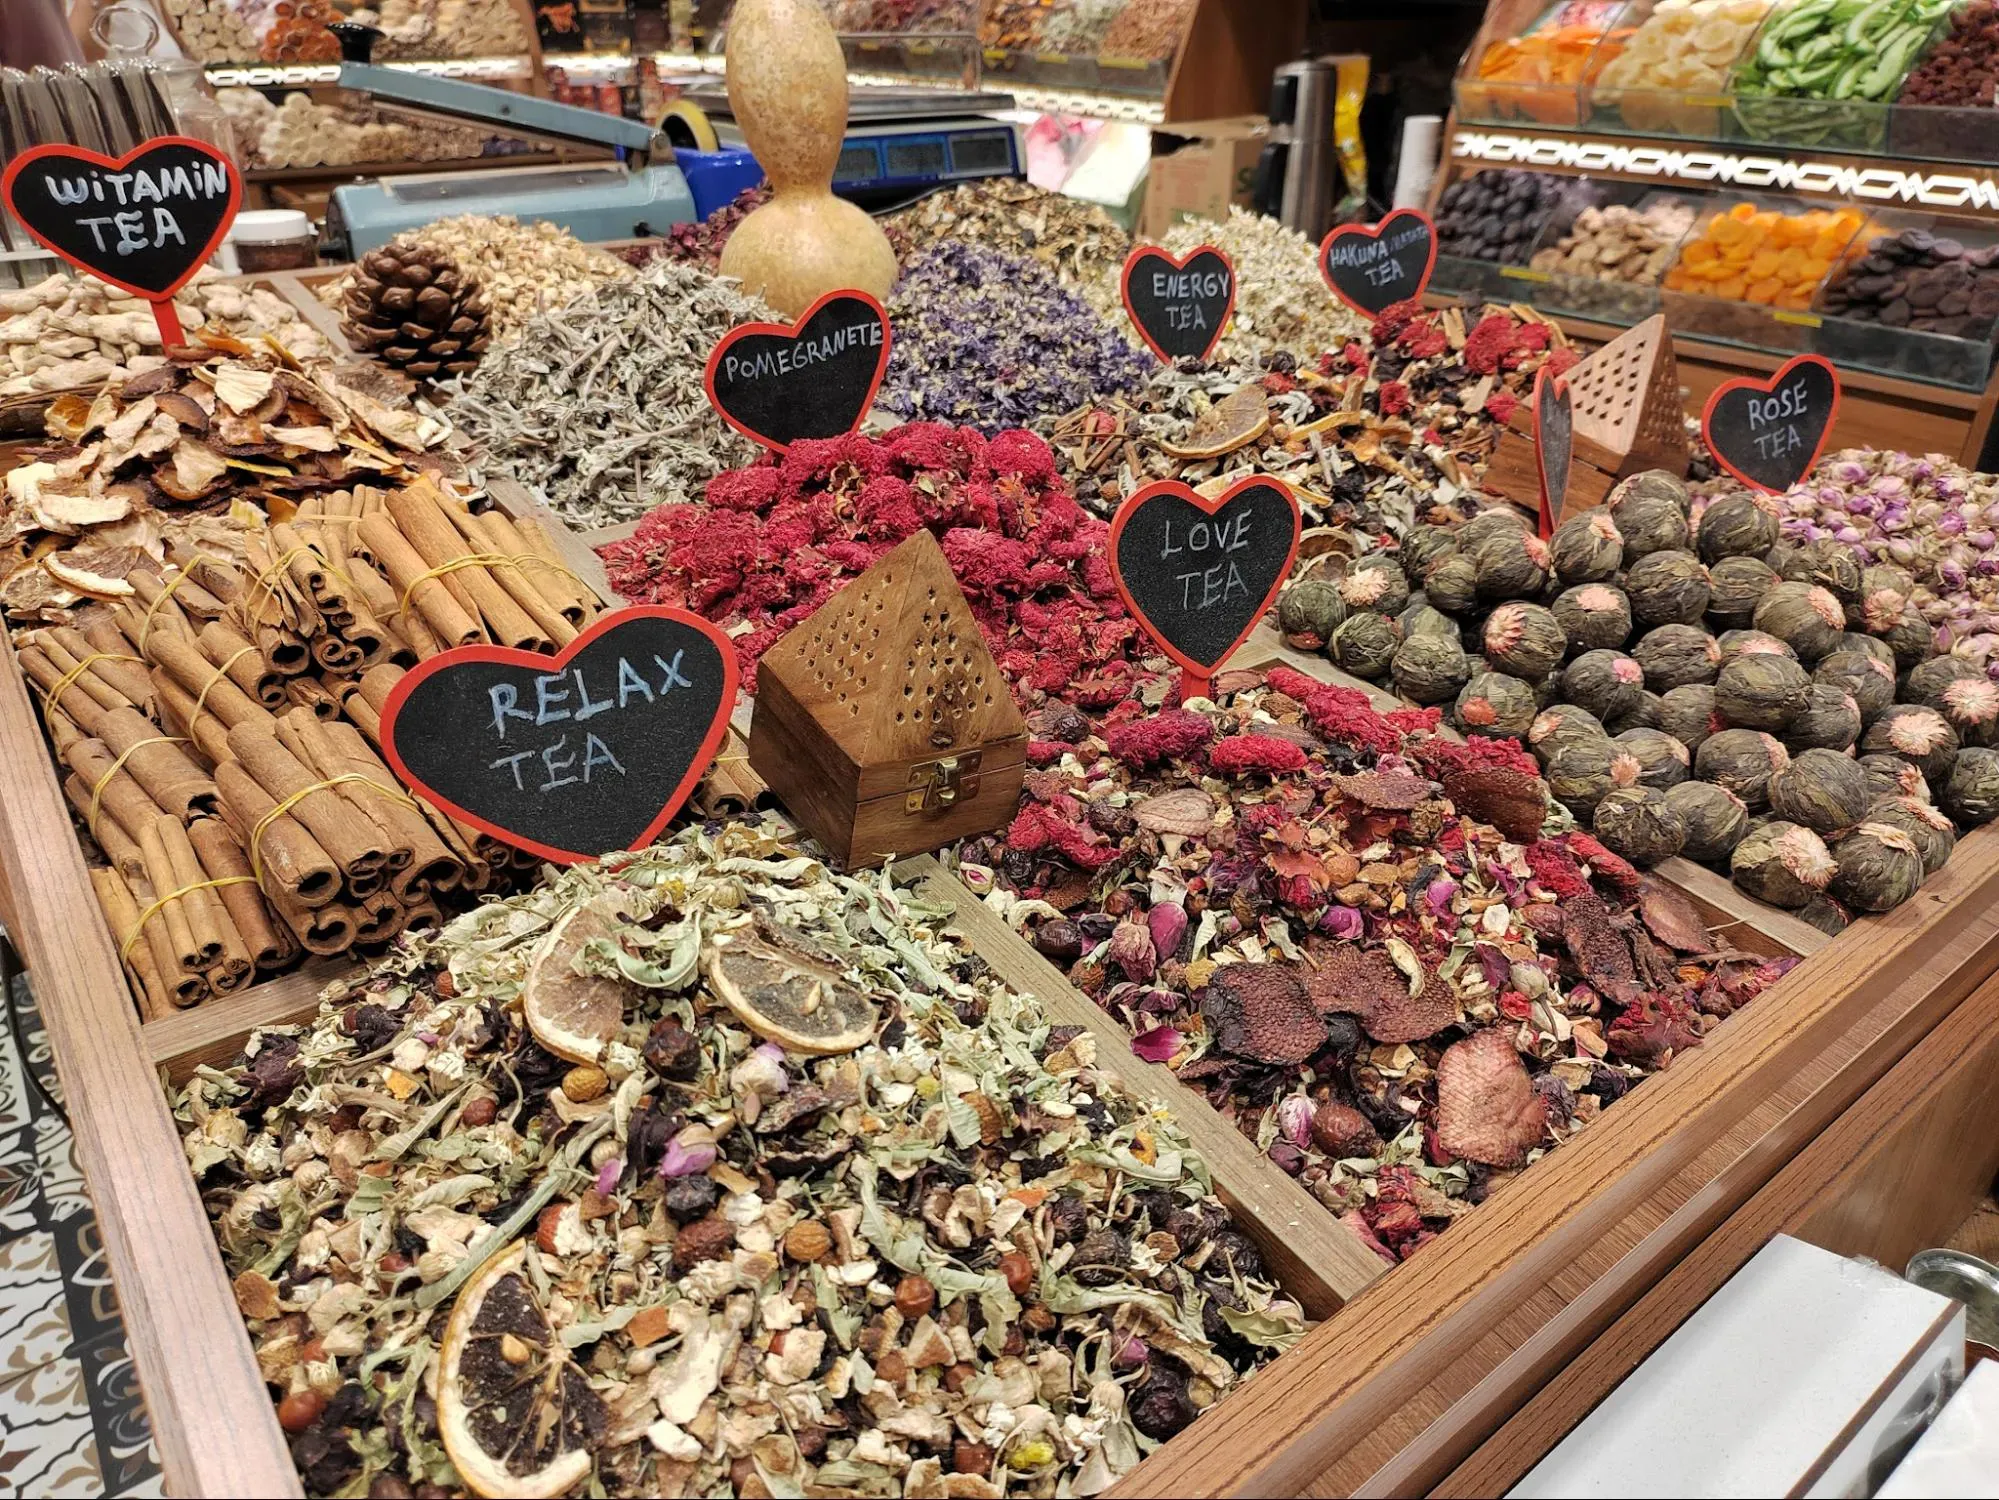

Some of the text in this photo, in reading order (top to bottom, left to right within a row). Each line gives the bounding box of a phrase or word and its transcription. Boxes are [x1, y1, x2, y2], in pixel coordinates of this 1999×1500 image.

[75, 207, 186, 256] TEA
[1330, 240, 1389, 269] HAKUNA
[1152, 272, 1230, 299] ENERGY
[1364, 258, 1405, 286] TEA
[1164, 304, 1207, 331] TEA
[1747, 378, 1808, 431] ROSE
[1753, 424, 1802, 460] TEA
[1160, 508, 1253, 560] LOVE
[1175, 561, 1249, 611] TEA
[487, 648, 692, 739] RELAX
[489, 732, 626, 792] TEA
